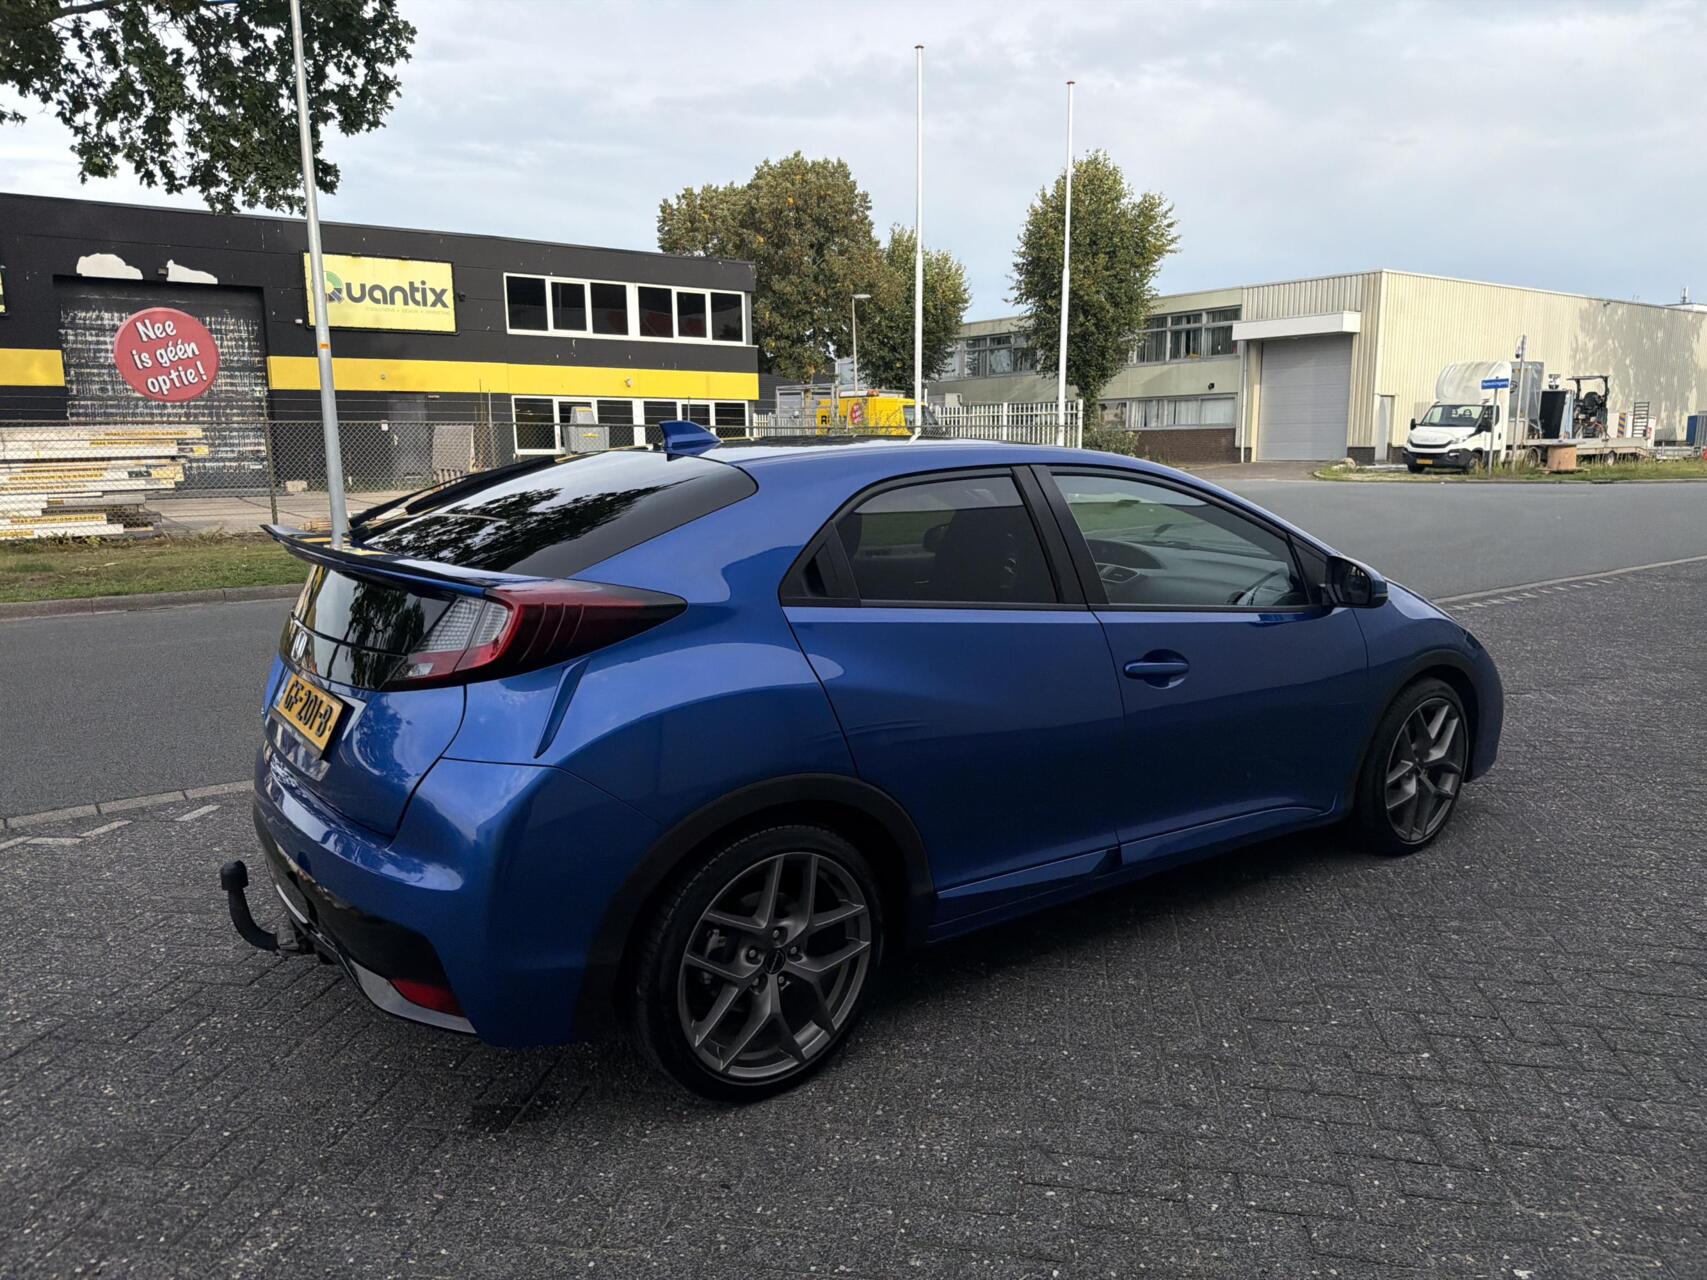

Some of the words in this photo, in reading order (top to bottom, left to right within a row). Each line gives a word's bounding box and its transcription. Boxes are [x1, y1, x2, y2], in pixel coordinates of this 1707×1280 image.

[136, 319, 177, 342] Nee
[131, 349, 152, 369] is
[155, 338, 200, 367] géén
[147, 360, 207, 395] optie!
